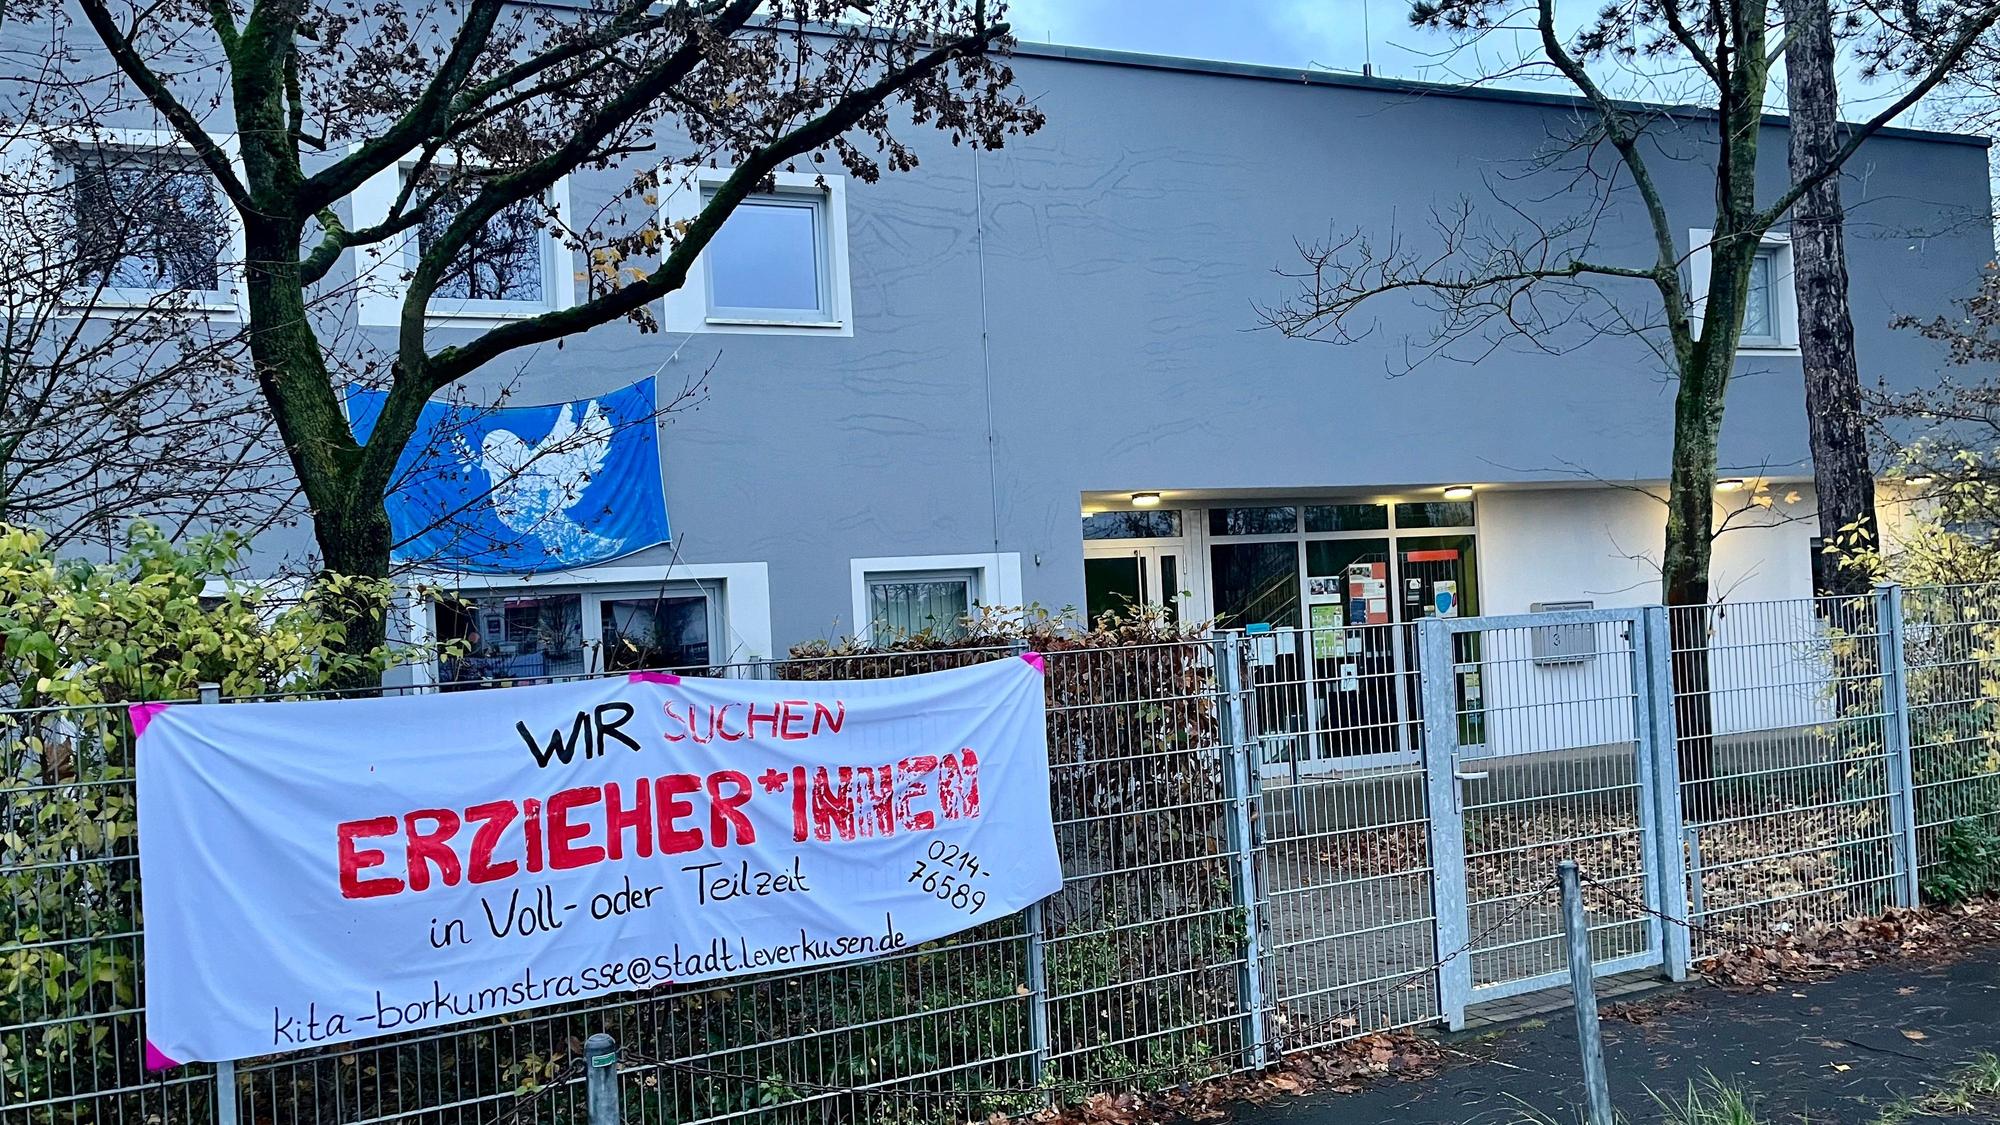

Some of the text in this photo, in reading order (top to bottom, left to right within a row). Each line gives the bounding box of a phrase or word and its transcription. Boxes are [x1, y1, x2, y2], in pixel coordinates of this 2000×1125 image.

[517, 700, 846, 768] WIR SUCHEN
[430, 917, 473, 948] in
[591, 876, 663, 919] oder
[682, 857, 810, 905] Teilzeit
[908, 861, 986, 914] 76589
[274, 912, 906, 1045] kita-borkumstrasse@stadt.leverkusen.de
